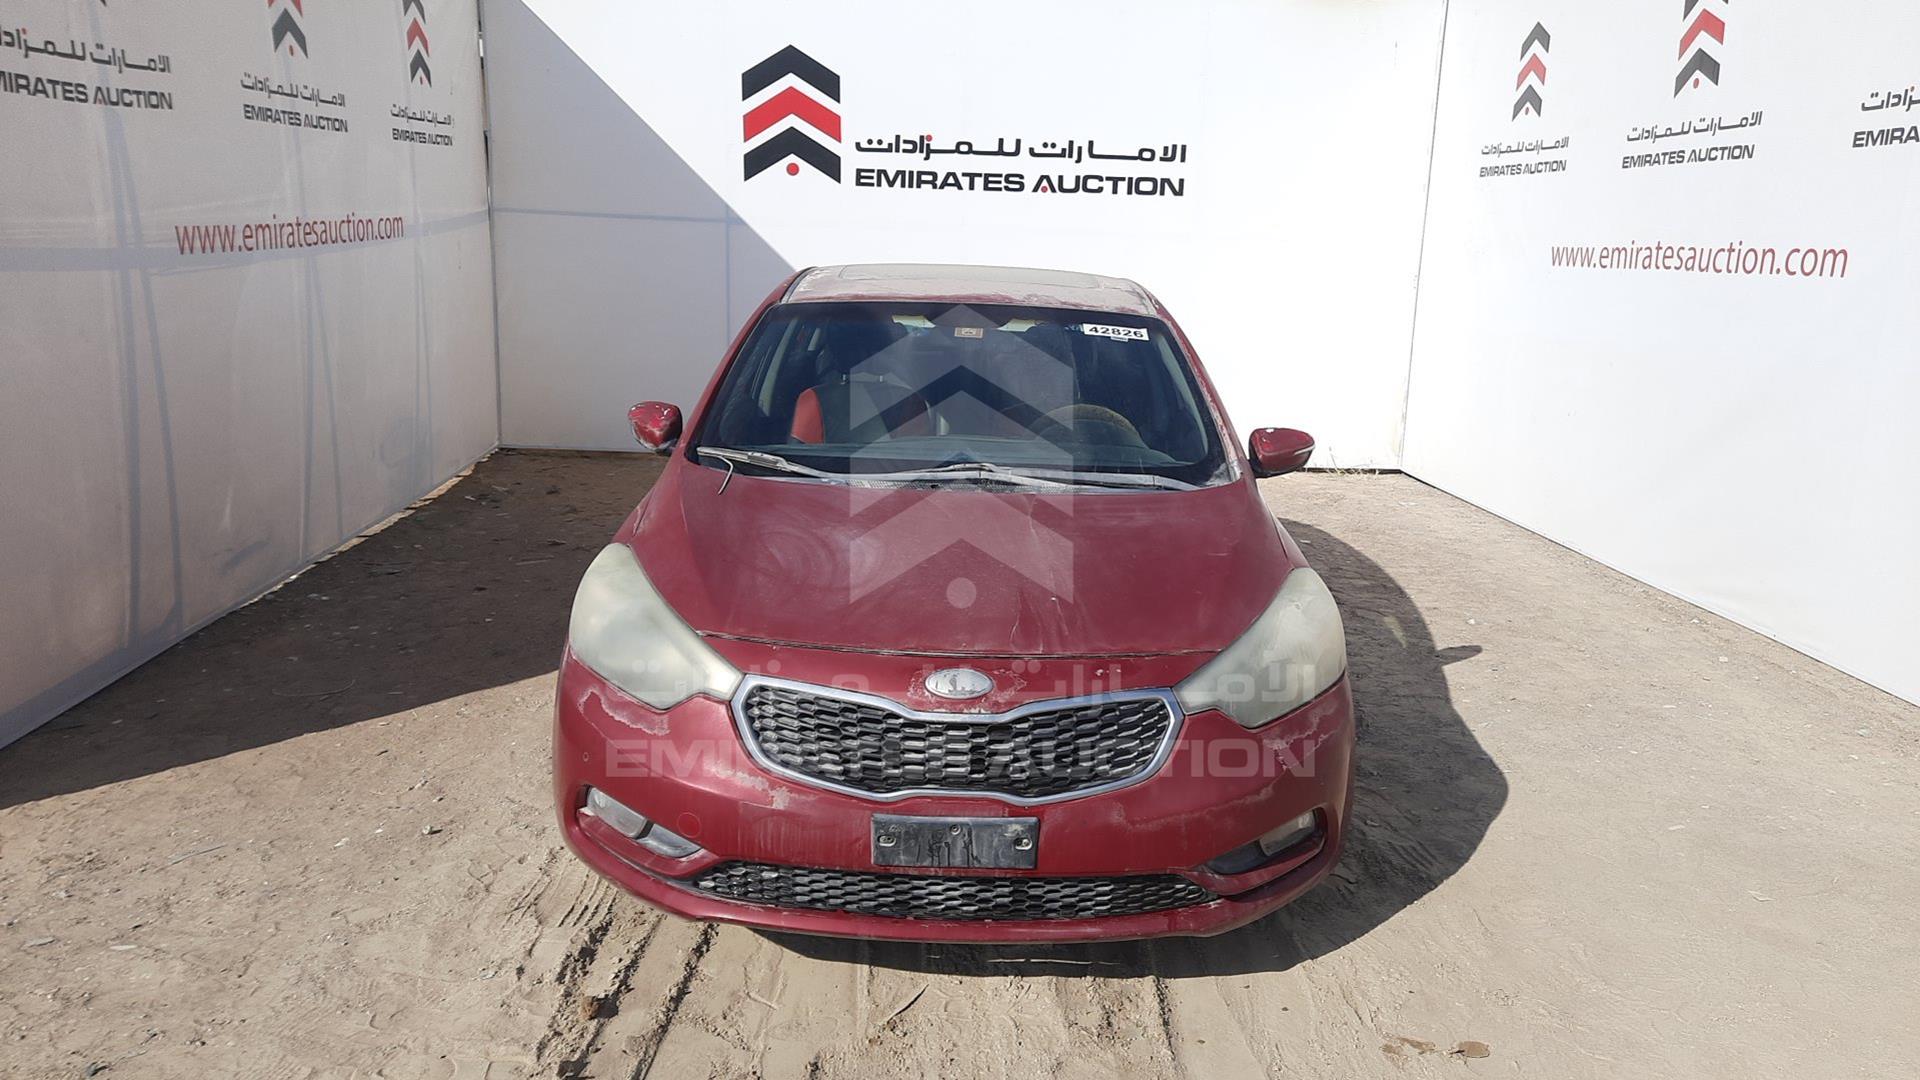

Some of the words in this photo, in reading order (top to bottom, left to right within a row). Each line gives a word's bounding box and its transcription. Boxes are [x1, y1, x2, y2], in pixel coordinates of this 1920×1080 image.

[93, 86, 173, 110] AUCTION
[243, 104, 302, 127] EMIRATES
[303, 113, 348, 132] AUCTION
[1693, 110, 1763, 137] الامارات
[392, 127, 427, 144] EMIRATES
[427, 133, 453, 146] AUCTION
[855, 134, 1021, 161] للمزادات
[1029, 139, 1187, 164] الامارات
[1621, 150, 1686, 169] EMIRATES
[1687, 144, 1755, 163] AUCTION
[1479, 163, 1522, 178] EMIRATES
[1522, 159, 1567, 175] AUCTION
[855, 168, 1025, 192] EMIRATES
[1032, 174, 1186, 197] AUCTION
[174, 212, 404, 256] www.emiratesauction.com
[1551, 240, 1848, 278] www.emiratesauction.com
[1089, 326, 1144, 338] 42826
